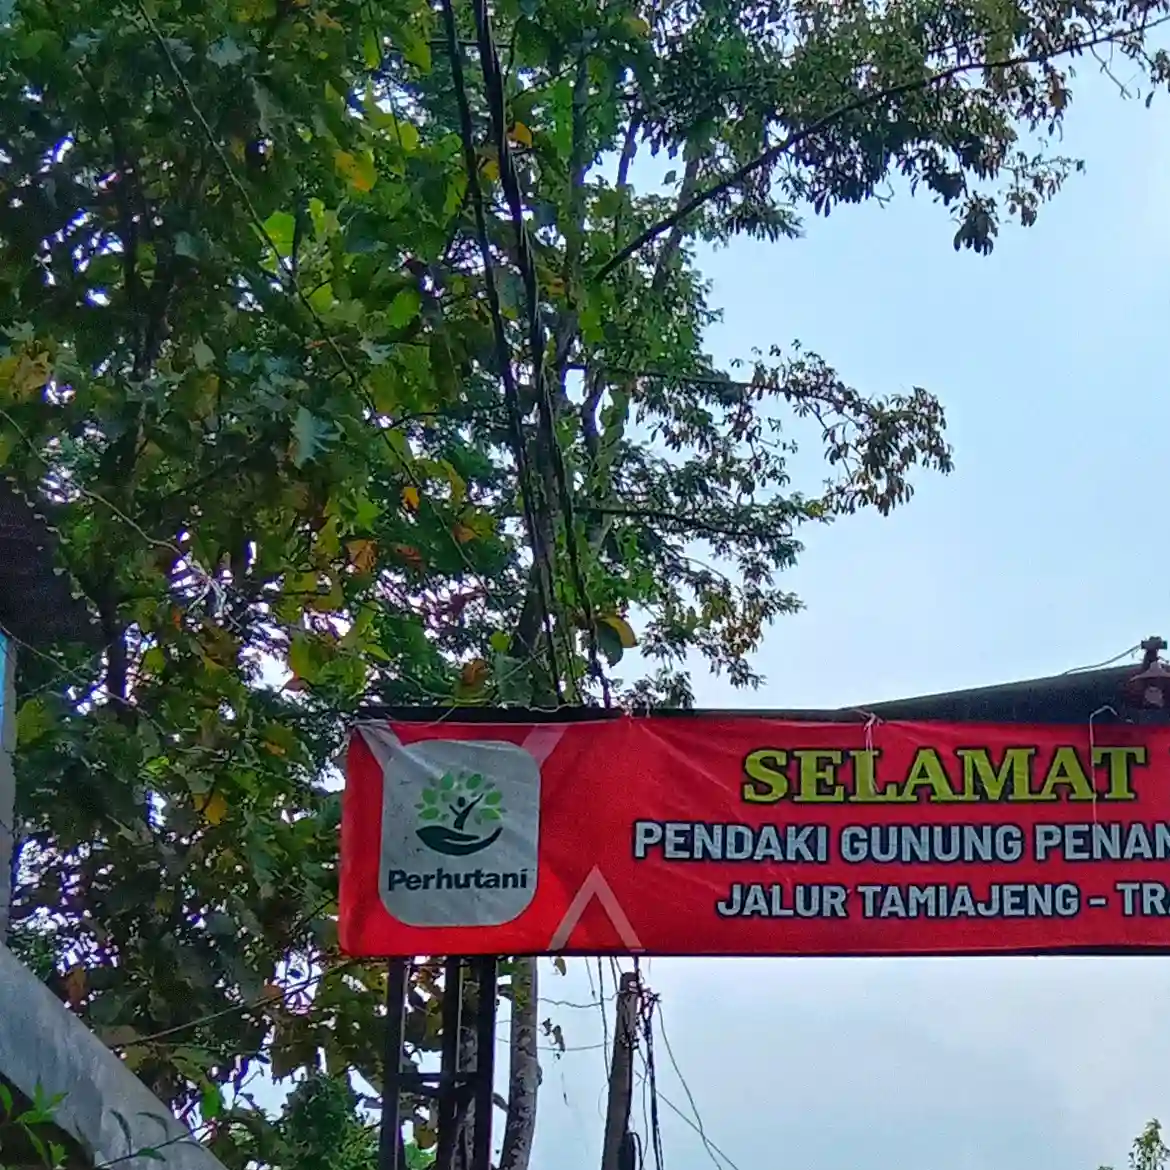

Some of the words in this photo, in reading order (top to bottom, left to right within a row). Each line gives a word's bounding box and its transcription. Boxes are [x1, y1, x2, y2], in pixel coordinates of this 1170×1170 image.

[742, 746, 1146, 802] SELAMAT
[634, 821, 828, 862] PENDAKI
[840, 824, 1023, 862] GUNUNG
[387, 867, 528, 892] Perhutani
[716, 883, 847, 918] JALUR
[857, 883, 1081, 918] TAMIAJENG
